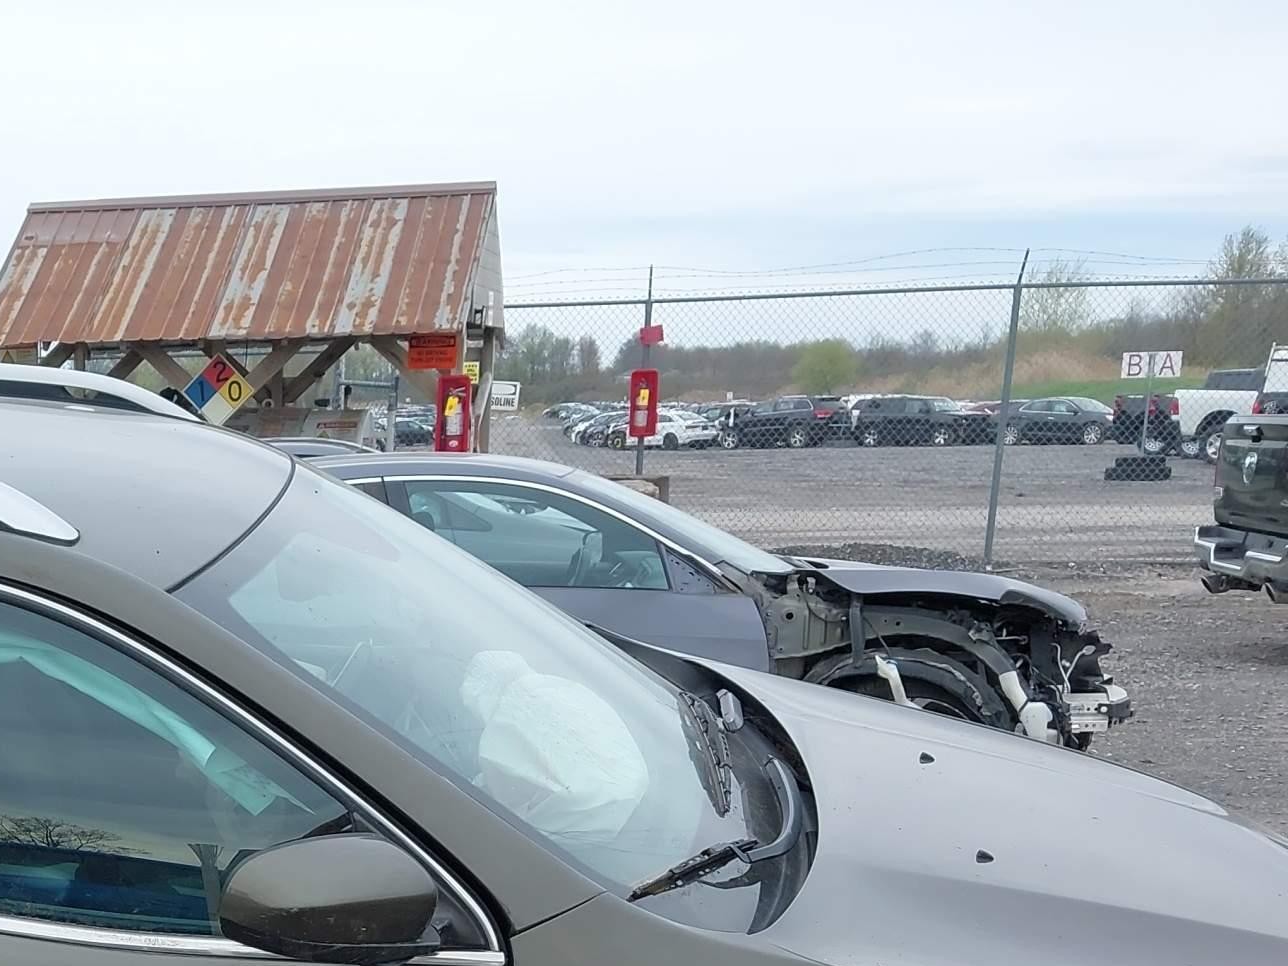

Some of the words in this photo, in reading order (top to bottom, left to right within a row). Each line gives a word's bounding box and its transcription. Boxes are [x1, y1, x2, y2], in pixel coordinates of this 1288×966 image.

[213, 361, 230, 383] 2
[196, 380, 205, 402] 1
[228, 380, 242, 402] 0
